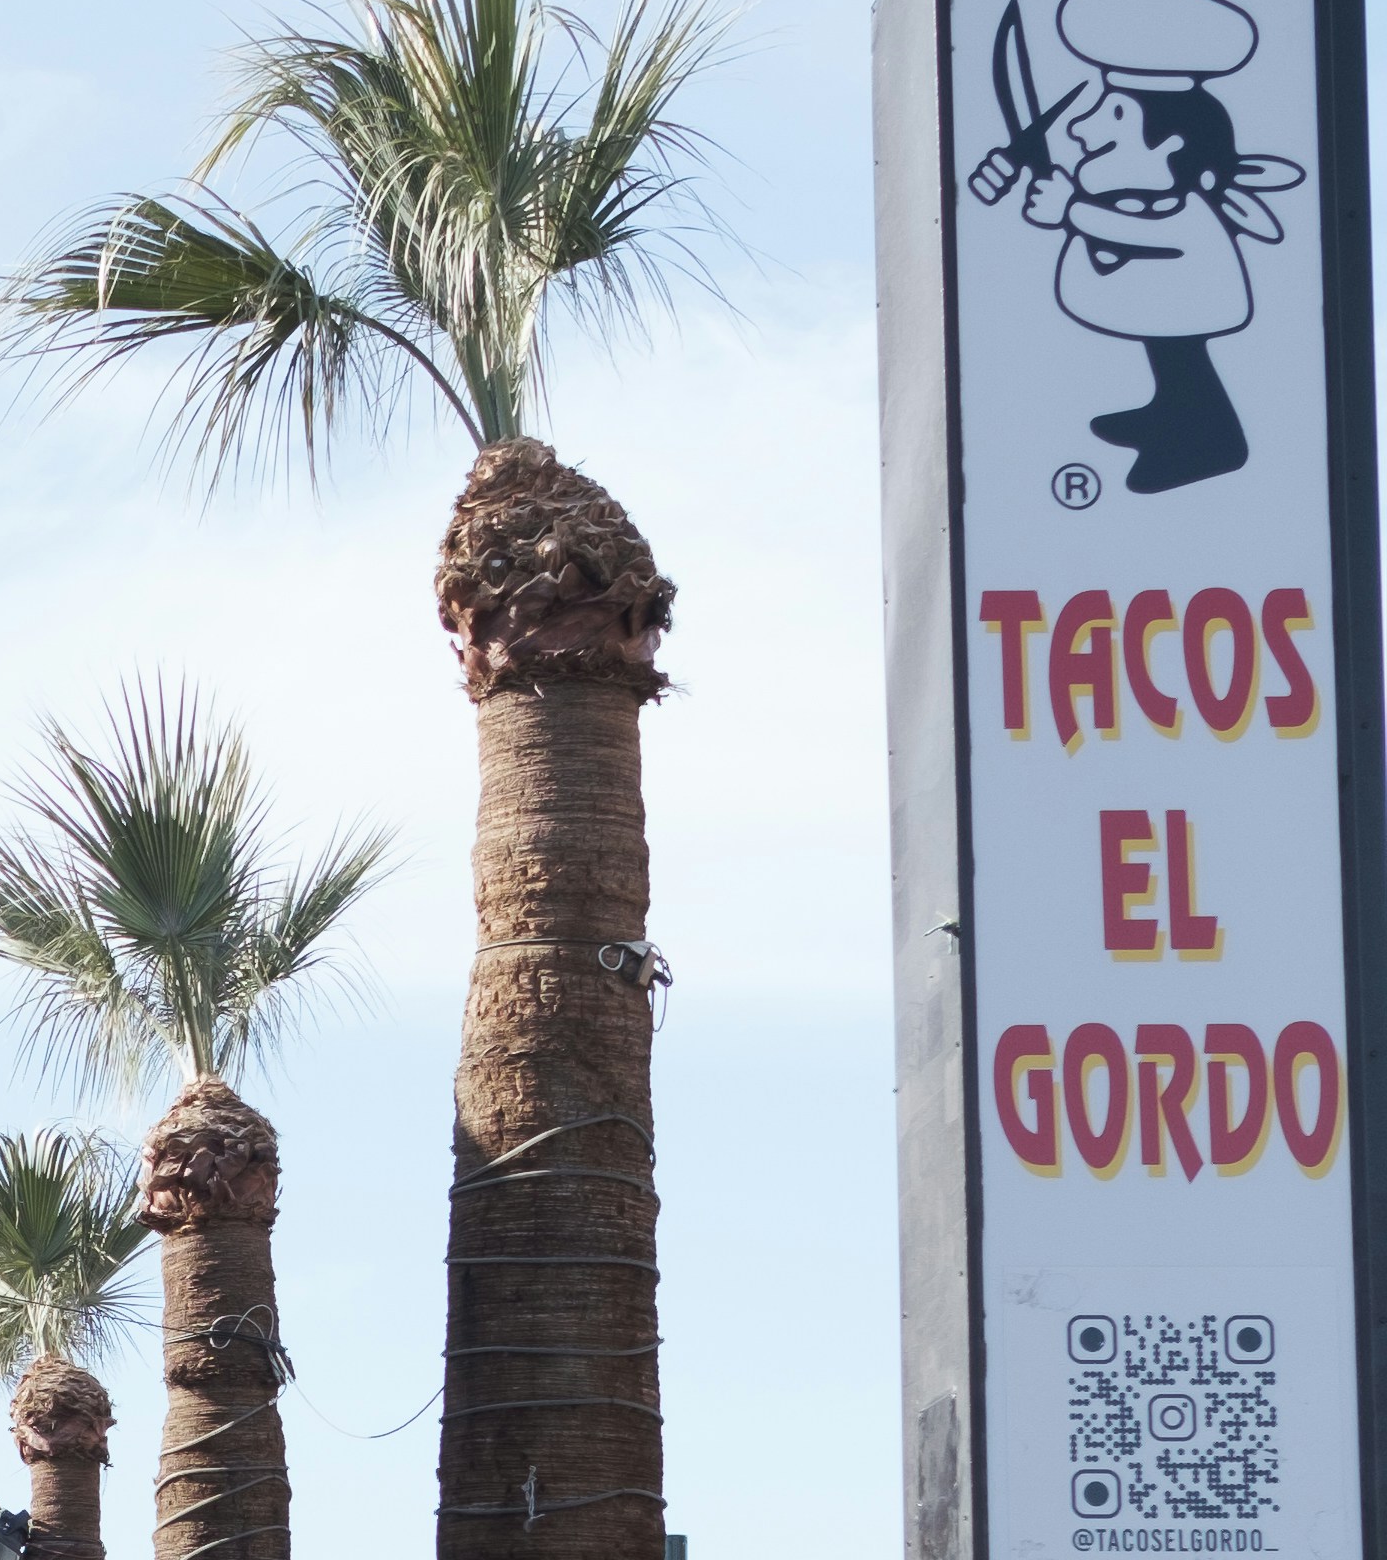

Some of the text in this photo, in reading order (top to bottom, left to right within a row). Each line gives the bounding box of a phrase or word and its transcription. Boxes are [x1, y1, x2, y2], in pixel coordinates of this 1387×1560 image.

[978, 586, 1321, 758] TACOS
[1098, 808, 1225, 962] EL
[993, 1020, 1345, 1185] GORDO
[1072, 1528, 1279, 1552] @TACOSELGORDO_
